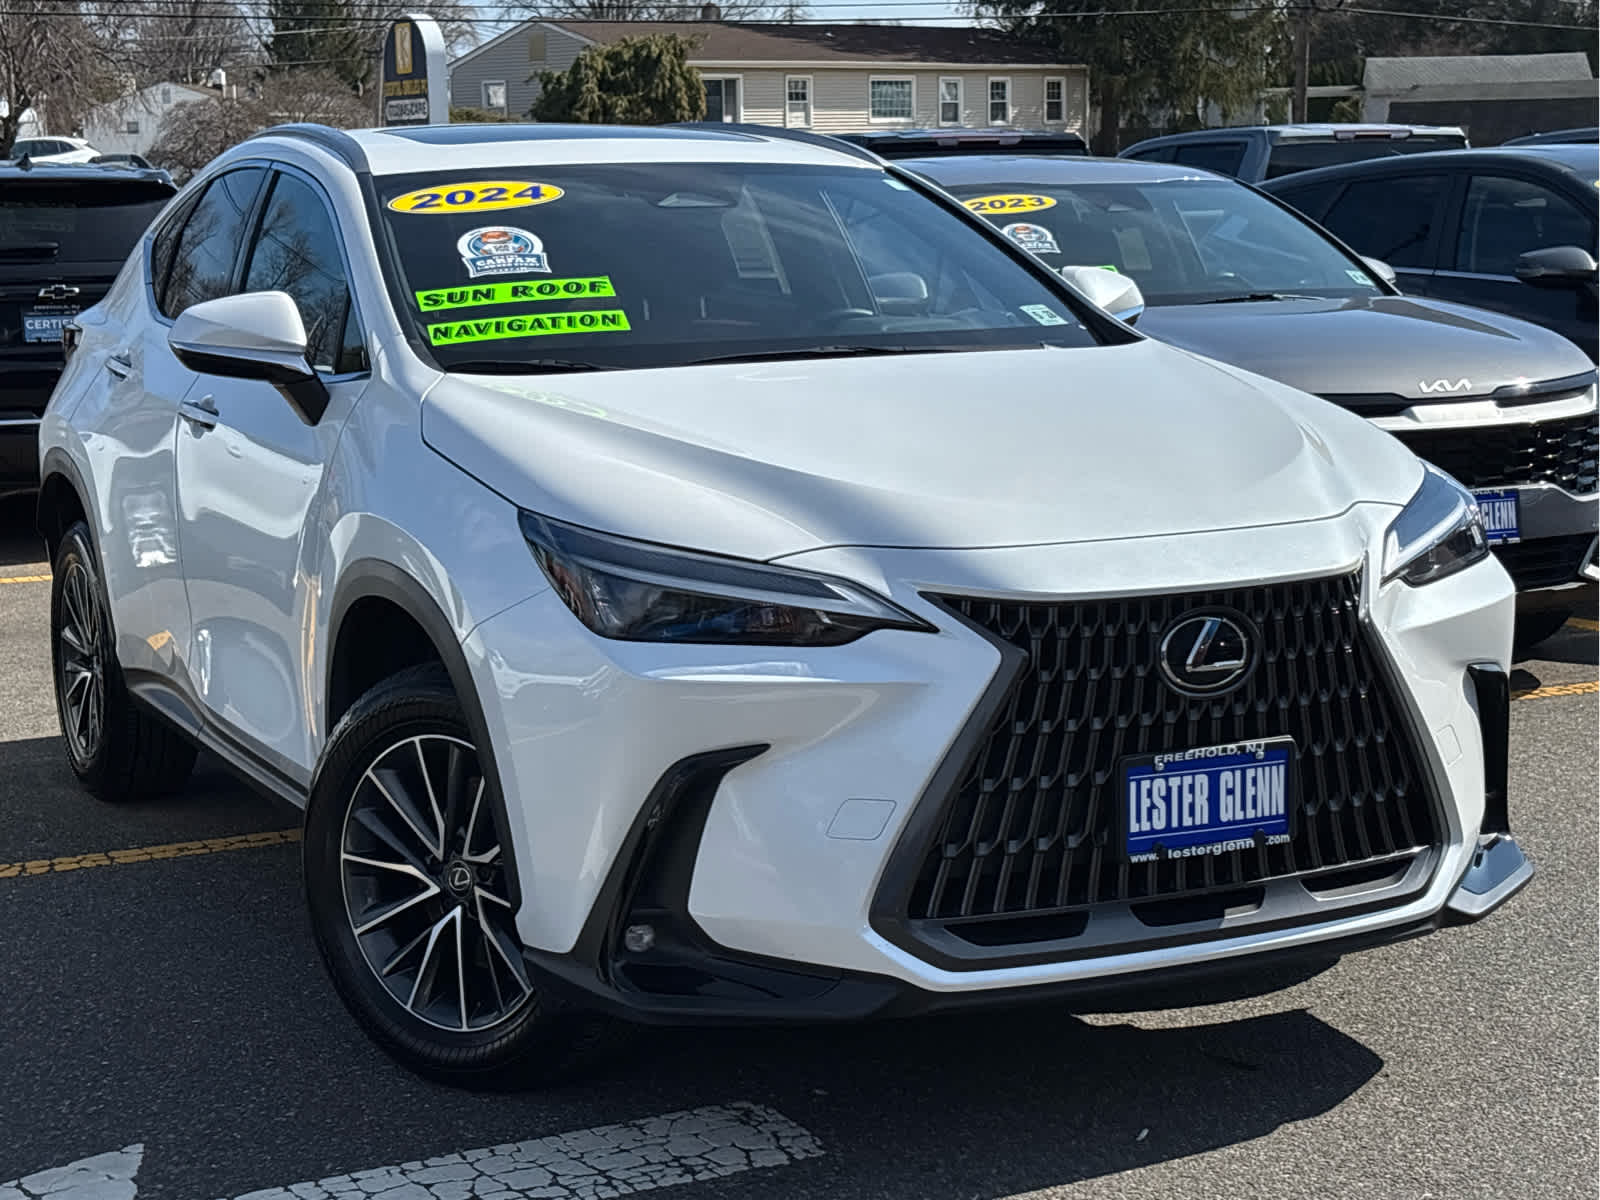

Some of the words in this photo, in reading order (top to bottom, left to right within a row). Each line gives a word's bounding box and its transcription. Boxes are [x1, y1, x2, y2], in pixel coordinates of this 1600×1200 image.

[410, 185, 545, 211] 2024
[968, 197, 1046, 212] 2023
[423, 287, 496, 308] SUN
[511, 280, 609, 298] ROOF
[432, 313, 621, 341] NAVIGATION
[1481, 501, 1517, 530] GLENN
[1129, 773, 1209, 833] LESTER
[1219, 764, 1286, 823] GLENN
